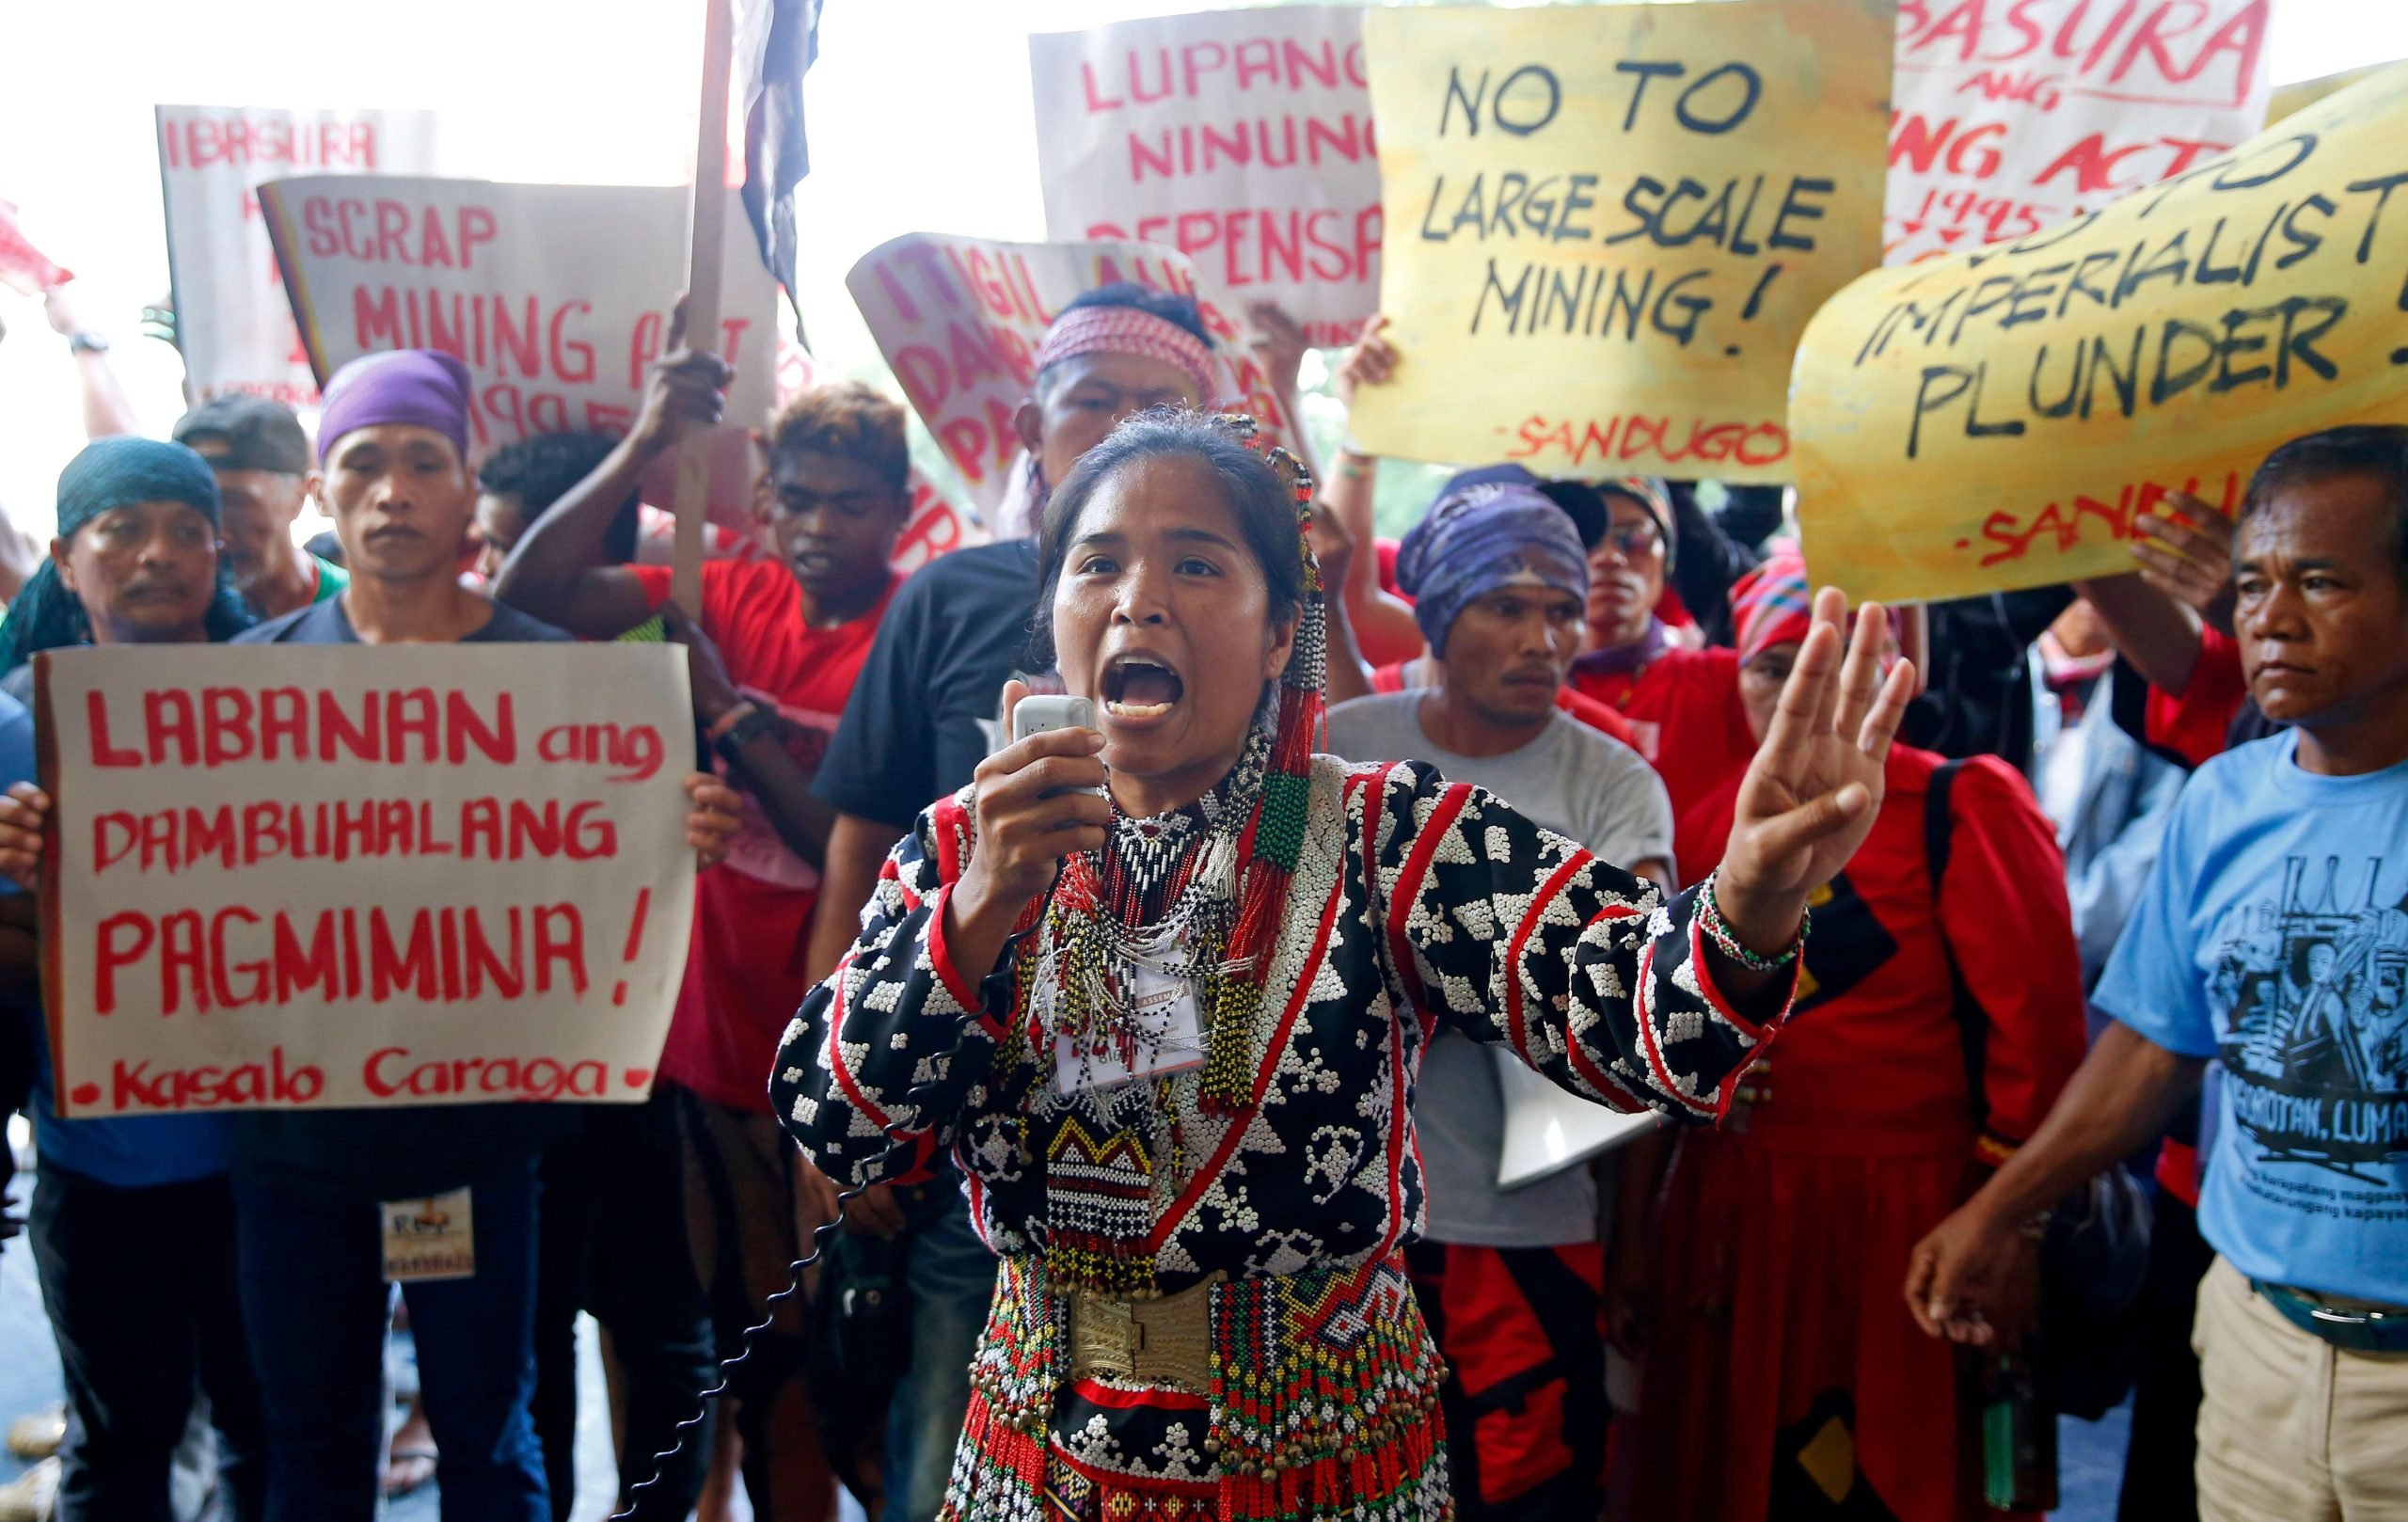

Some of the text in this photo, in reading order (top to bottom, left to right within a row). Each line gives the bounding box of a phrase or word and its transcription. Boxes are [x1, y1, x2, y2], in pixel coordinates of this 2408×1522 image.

[1440, 61, 1762, 137] NO TO
[1955, 70, 2069, 112] ANG
[1887, 109, 2239, 194] NG ACT
[303, 194, 499, 270] SCRAP
[1086, 202, 1384, 288] PENSA
[1855, 171, 2408, 368] IMPERIALIST
[353, 282, 597, 386] MINING
[630, 310, 752, 397] AT
[87, 686, 665, 782] LABANAN ang
[94, 796, 618, 876] DAMBUHALANG
[112, 1045, 608, 1111] Kasalo Caraga
